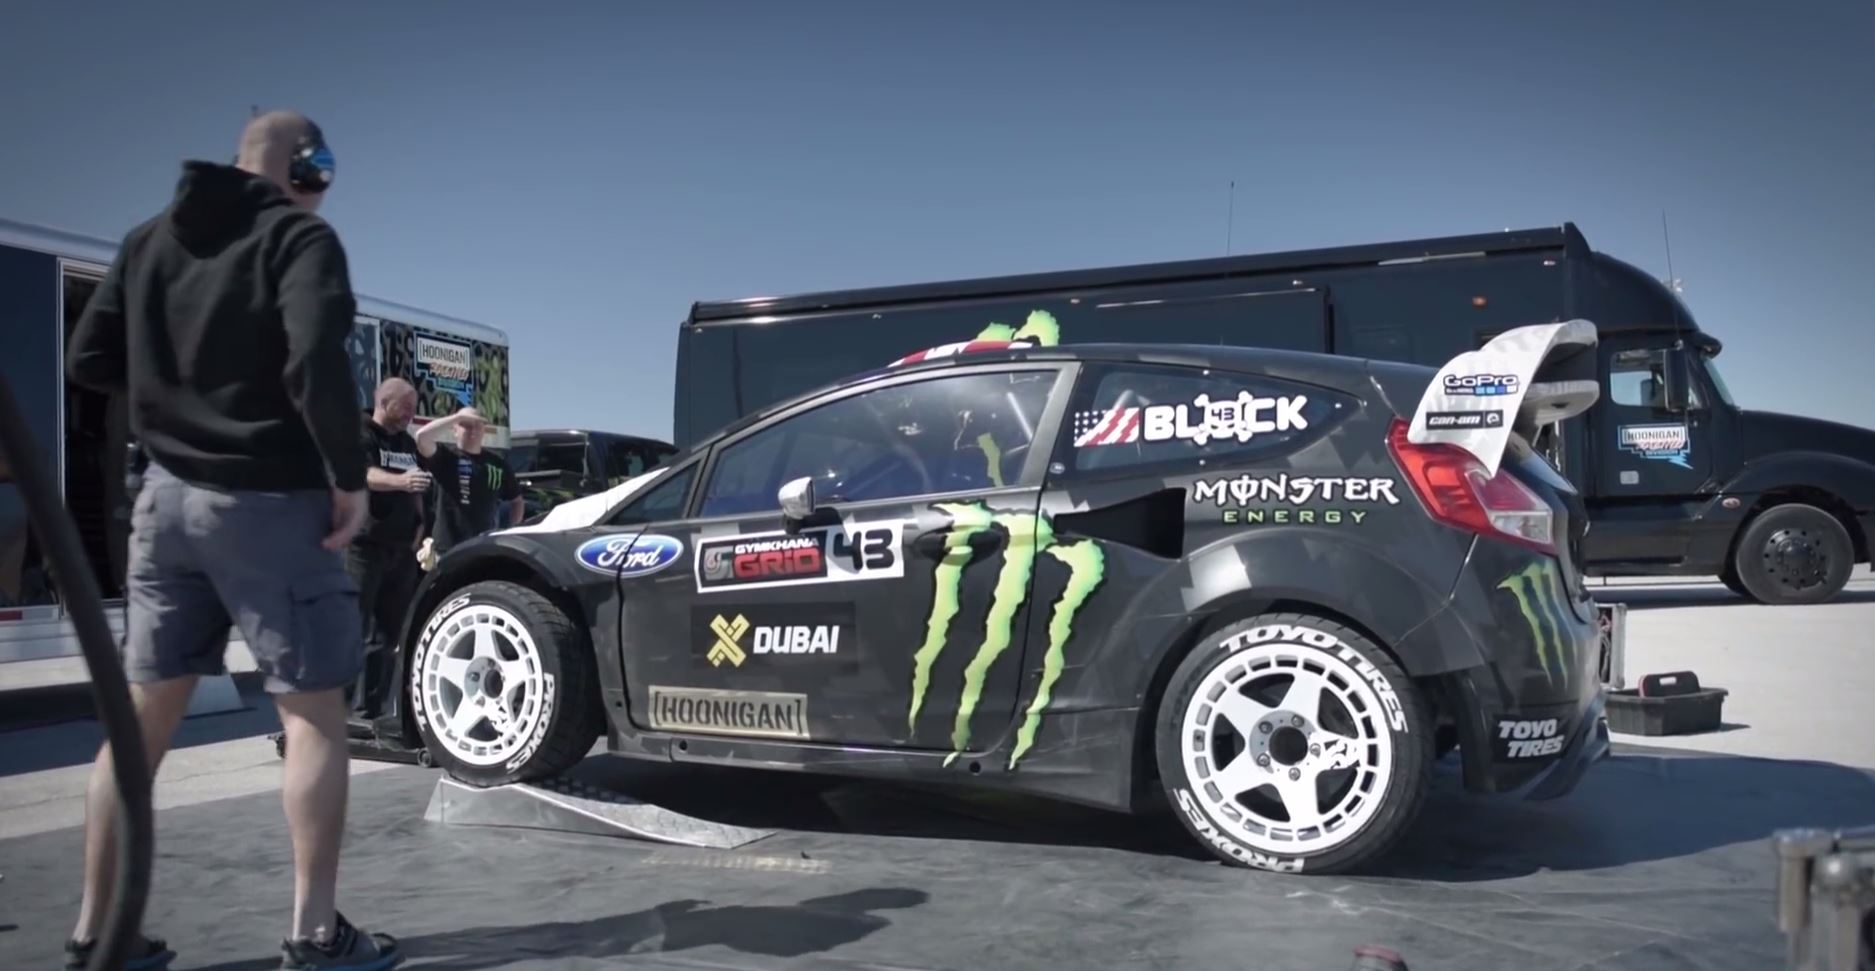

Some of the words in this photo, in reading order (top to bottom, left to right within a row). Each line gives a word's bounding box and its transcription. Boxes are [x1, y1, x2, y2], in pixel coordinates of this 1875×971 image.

[1444, 374, 1518, 388] GoPro
[1211, 408, 1235, 420] 43
[1223, 510, 1367, 524] ENERGY
[597, 538, 665, 568] Ford
[735, 537, 819, 555] GYMKHANA
[832, 529, 895, 571] 43
[753, 625, 840, 654] DUBAI
[1498, 718, 1558, 738] TOYO
[1507, 735, 1565, 758] TIRES
[1173, 788, 1305, 874] PROXES
